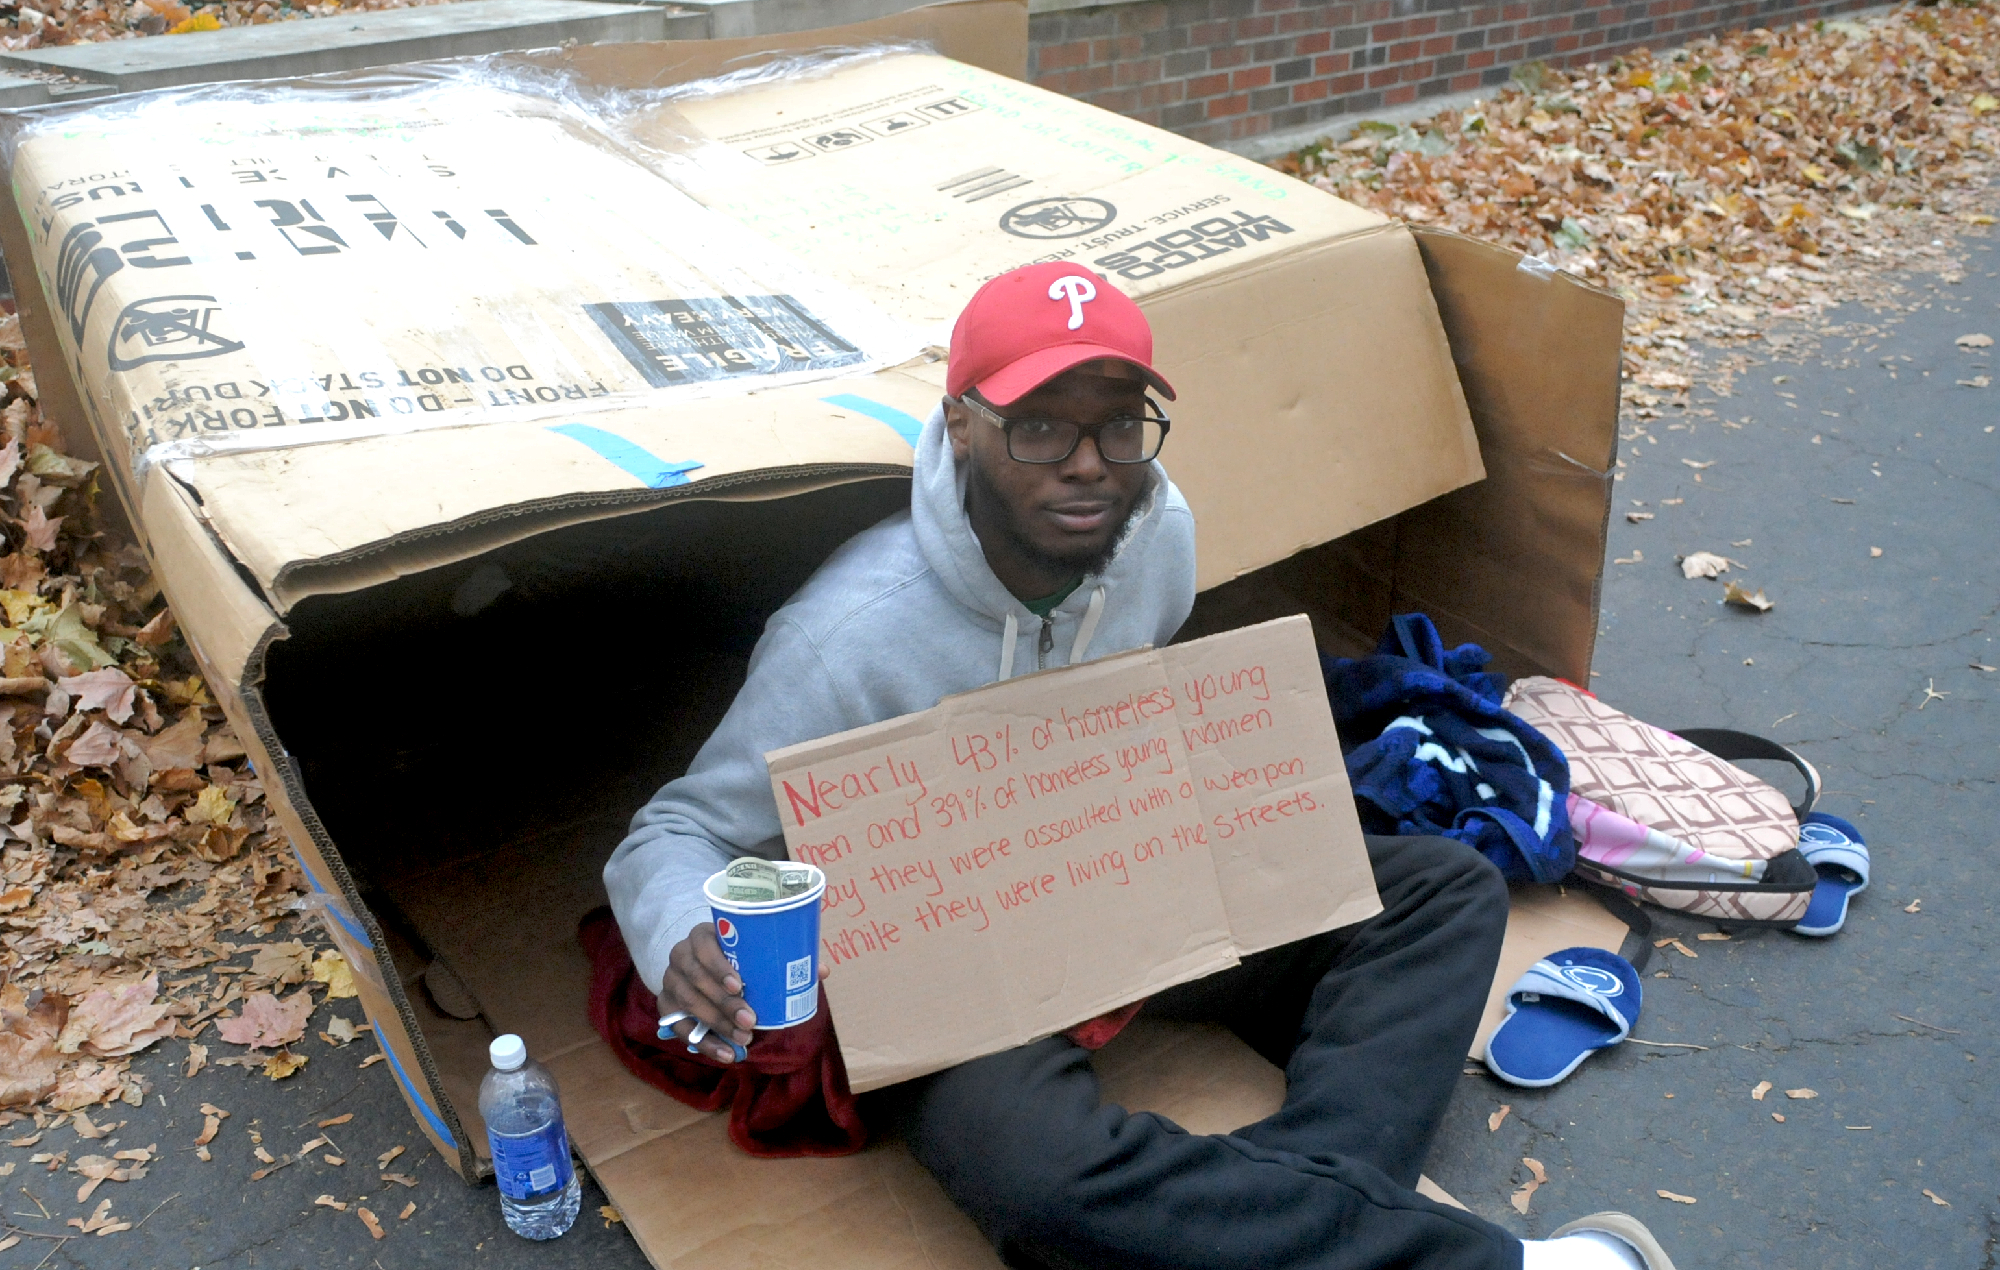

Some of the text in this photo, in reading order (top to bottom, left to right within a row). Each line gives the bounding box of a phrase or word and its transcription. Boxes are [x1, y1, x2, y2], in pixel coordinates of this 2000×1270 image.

[1093, 210, 1272, 270] TOOLS
[1116, 218, 1295, 281] MATCO
[1047, 275, 1097, 330] P
[398, 366, 476, 386] NOT
[481, 363, 532, 382] DO
[490, 381, 611, 407] FRONT
[172, 404, 288, 434] FORK
[298, 397, 376, 424] NOT
[782, 665, 1269, 826] Nearly 43% of homeless young
[796, 834, 852, 868] men
[866, 805, 921, 848] and
[932, 782, 988, 828] 39%
[995, 778, 1018, 810] of
[1021, 751, 1110, 801] homeless
[1116, 735, 1171, 781] young
[870, 855, 941, 897] they
[950, 835, 1011, 875] were
[1023, 799, 1122, 848] assaulted
[1129, 784, 1172, 816] with
[1179, 778, 1194, 798] a
[1204, 757, 1305, 792] weapon
[914, 896, 989, 932] they
[996, 871, 1056, 911] were
[1066, 850, 1129, 886] living
[1135, 835, 1164, 861] on
[1172, 820, 1208, 851] the
